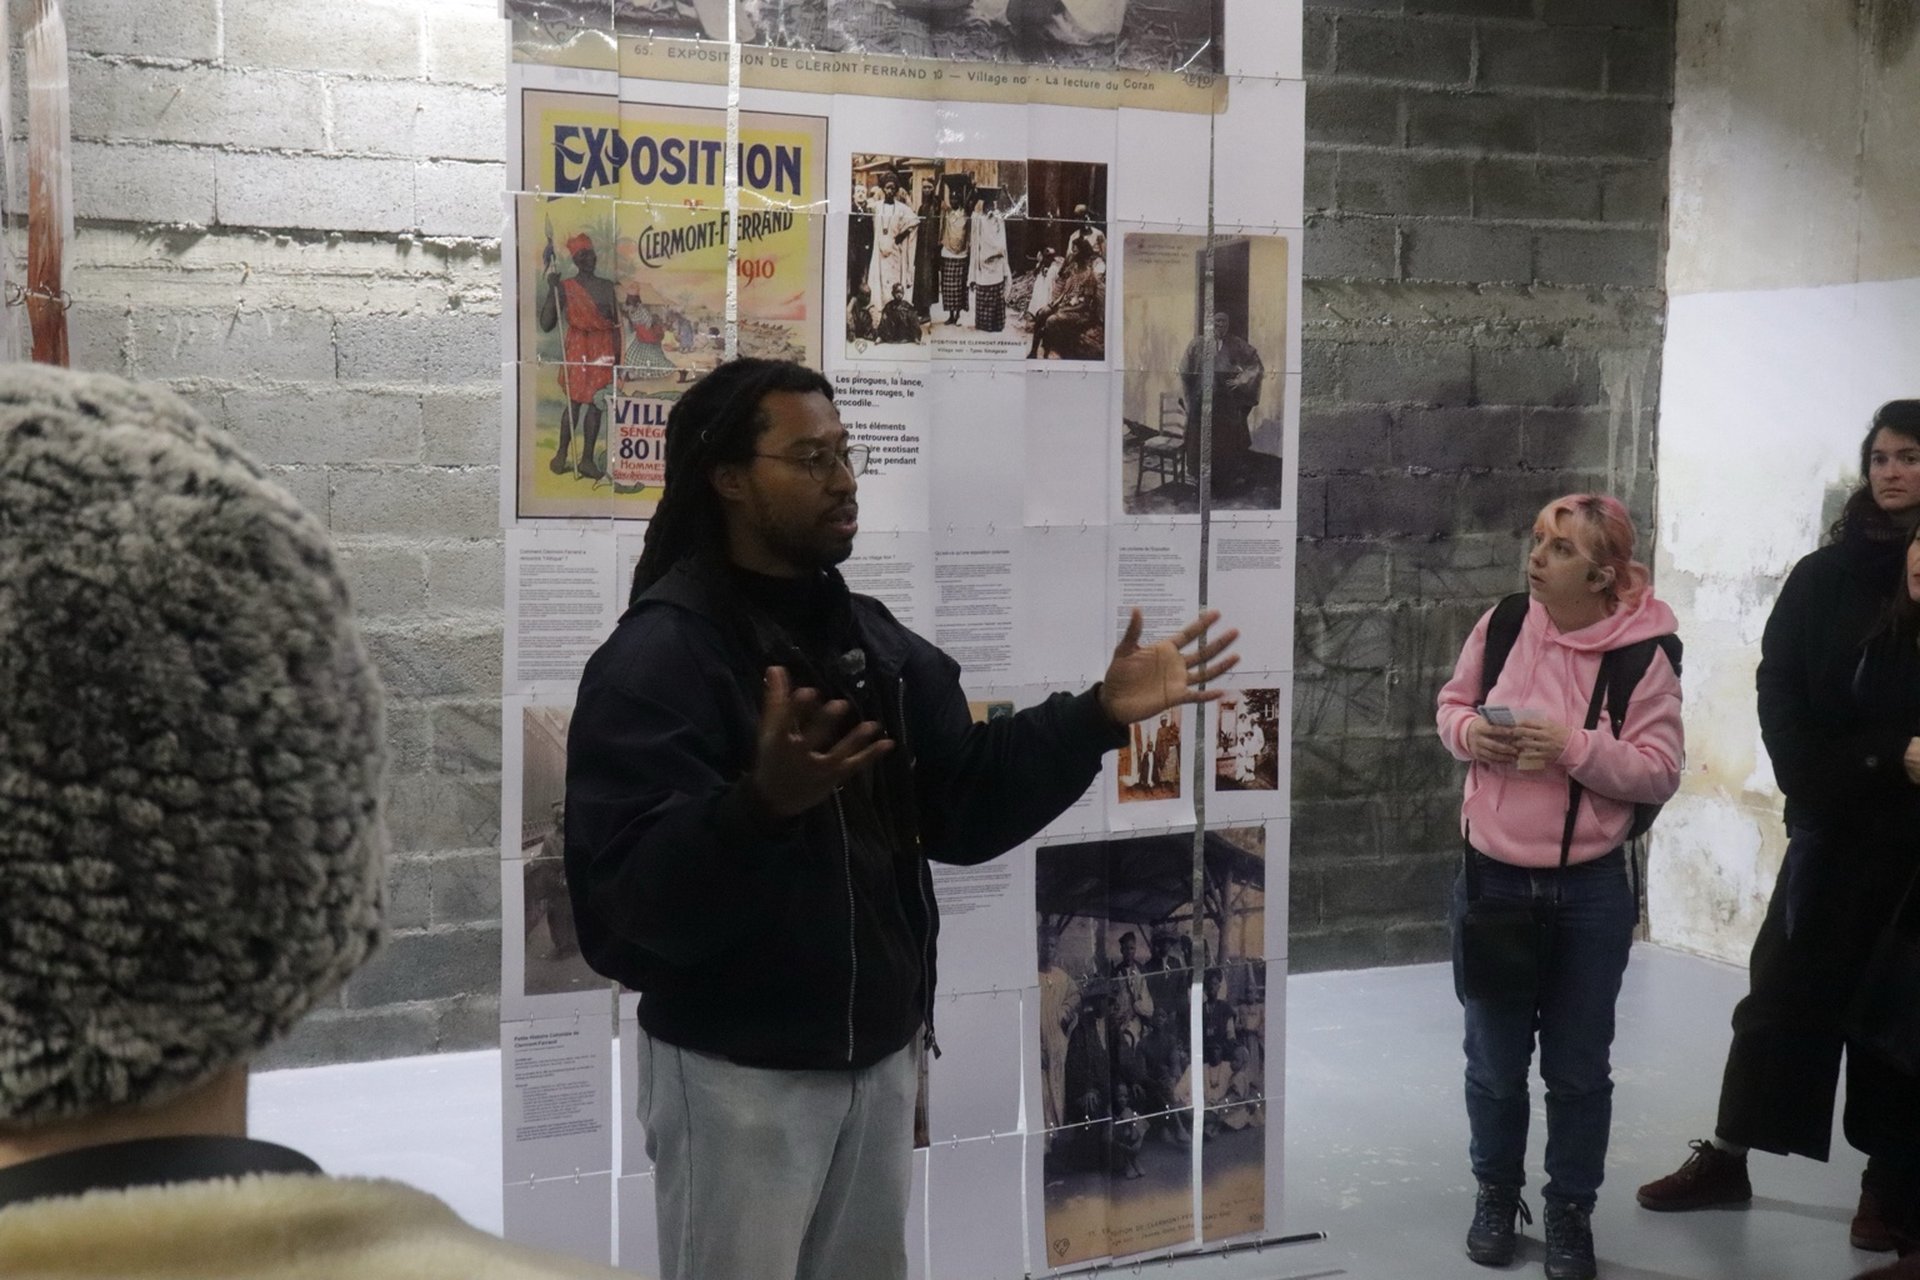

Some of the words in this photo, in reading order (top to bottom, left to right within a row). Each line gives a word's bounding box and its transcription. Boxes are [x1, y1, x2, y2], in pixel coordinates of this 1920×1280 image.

[770, 57, 788, 68] DE
[863, 64, 927, 79] FERRAND
[967, 71, 1008, 86] Village
[1045, 75, 1058, 85] La
[1063, 77, 1101, 89] lecture
[1105, 81, 1119, 90] du
[1123, 78, 1155, 91] Coran
[551, 124, 802, 201] EXPOSITION
[737, 257, 775, 288] 1910
[836, 375, 850, 383] Les
[852, 376, 889, 386] pirogues,
[891, 377, 898, 385] la
[900, 378, 924, 387] lance,
[849, 387, 873, 395] lèvres
[876, 390, 905, 398] rouges,
[612, 398, 666, 426] VILL
[855, 421, 867, 429] les
[869, 421, 906, 430] éléments
[857, 433, 899, 442] retrouvera
[901, 434, 920, 442] dans
[620, 437, 650, 460] 80
[884, 457, 916, 465] pendant
